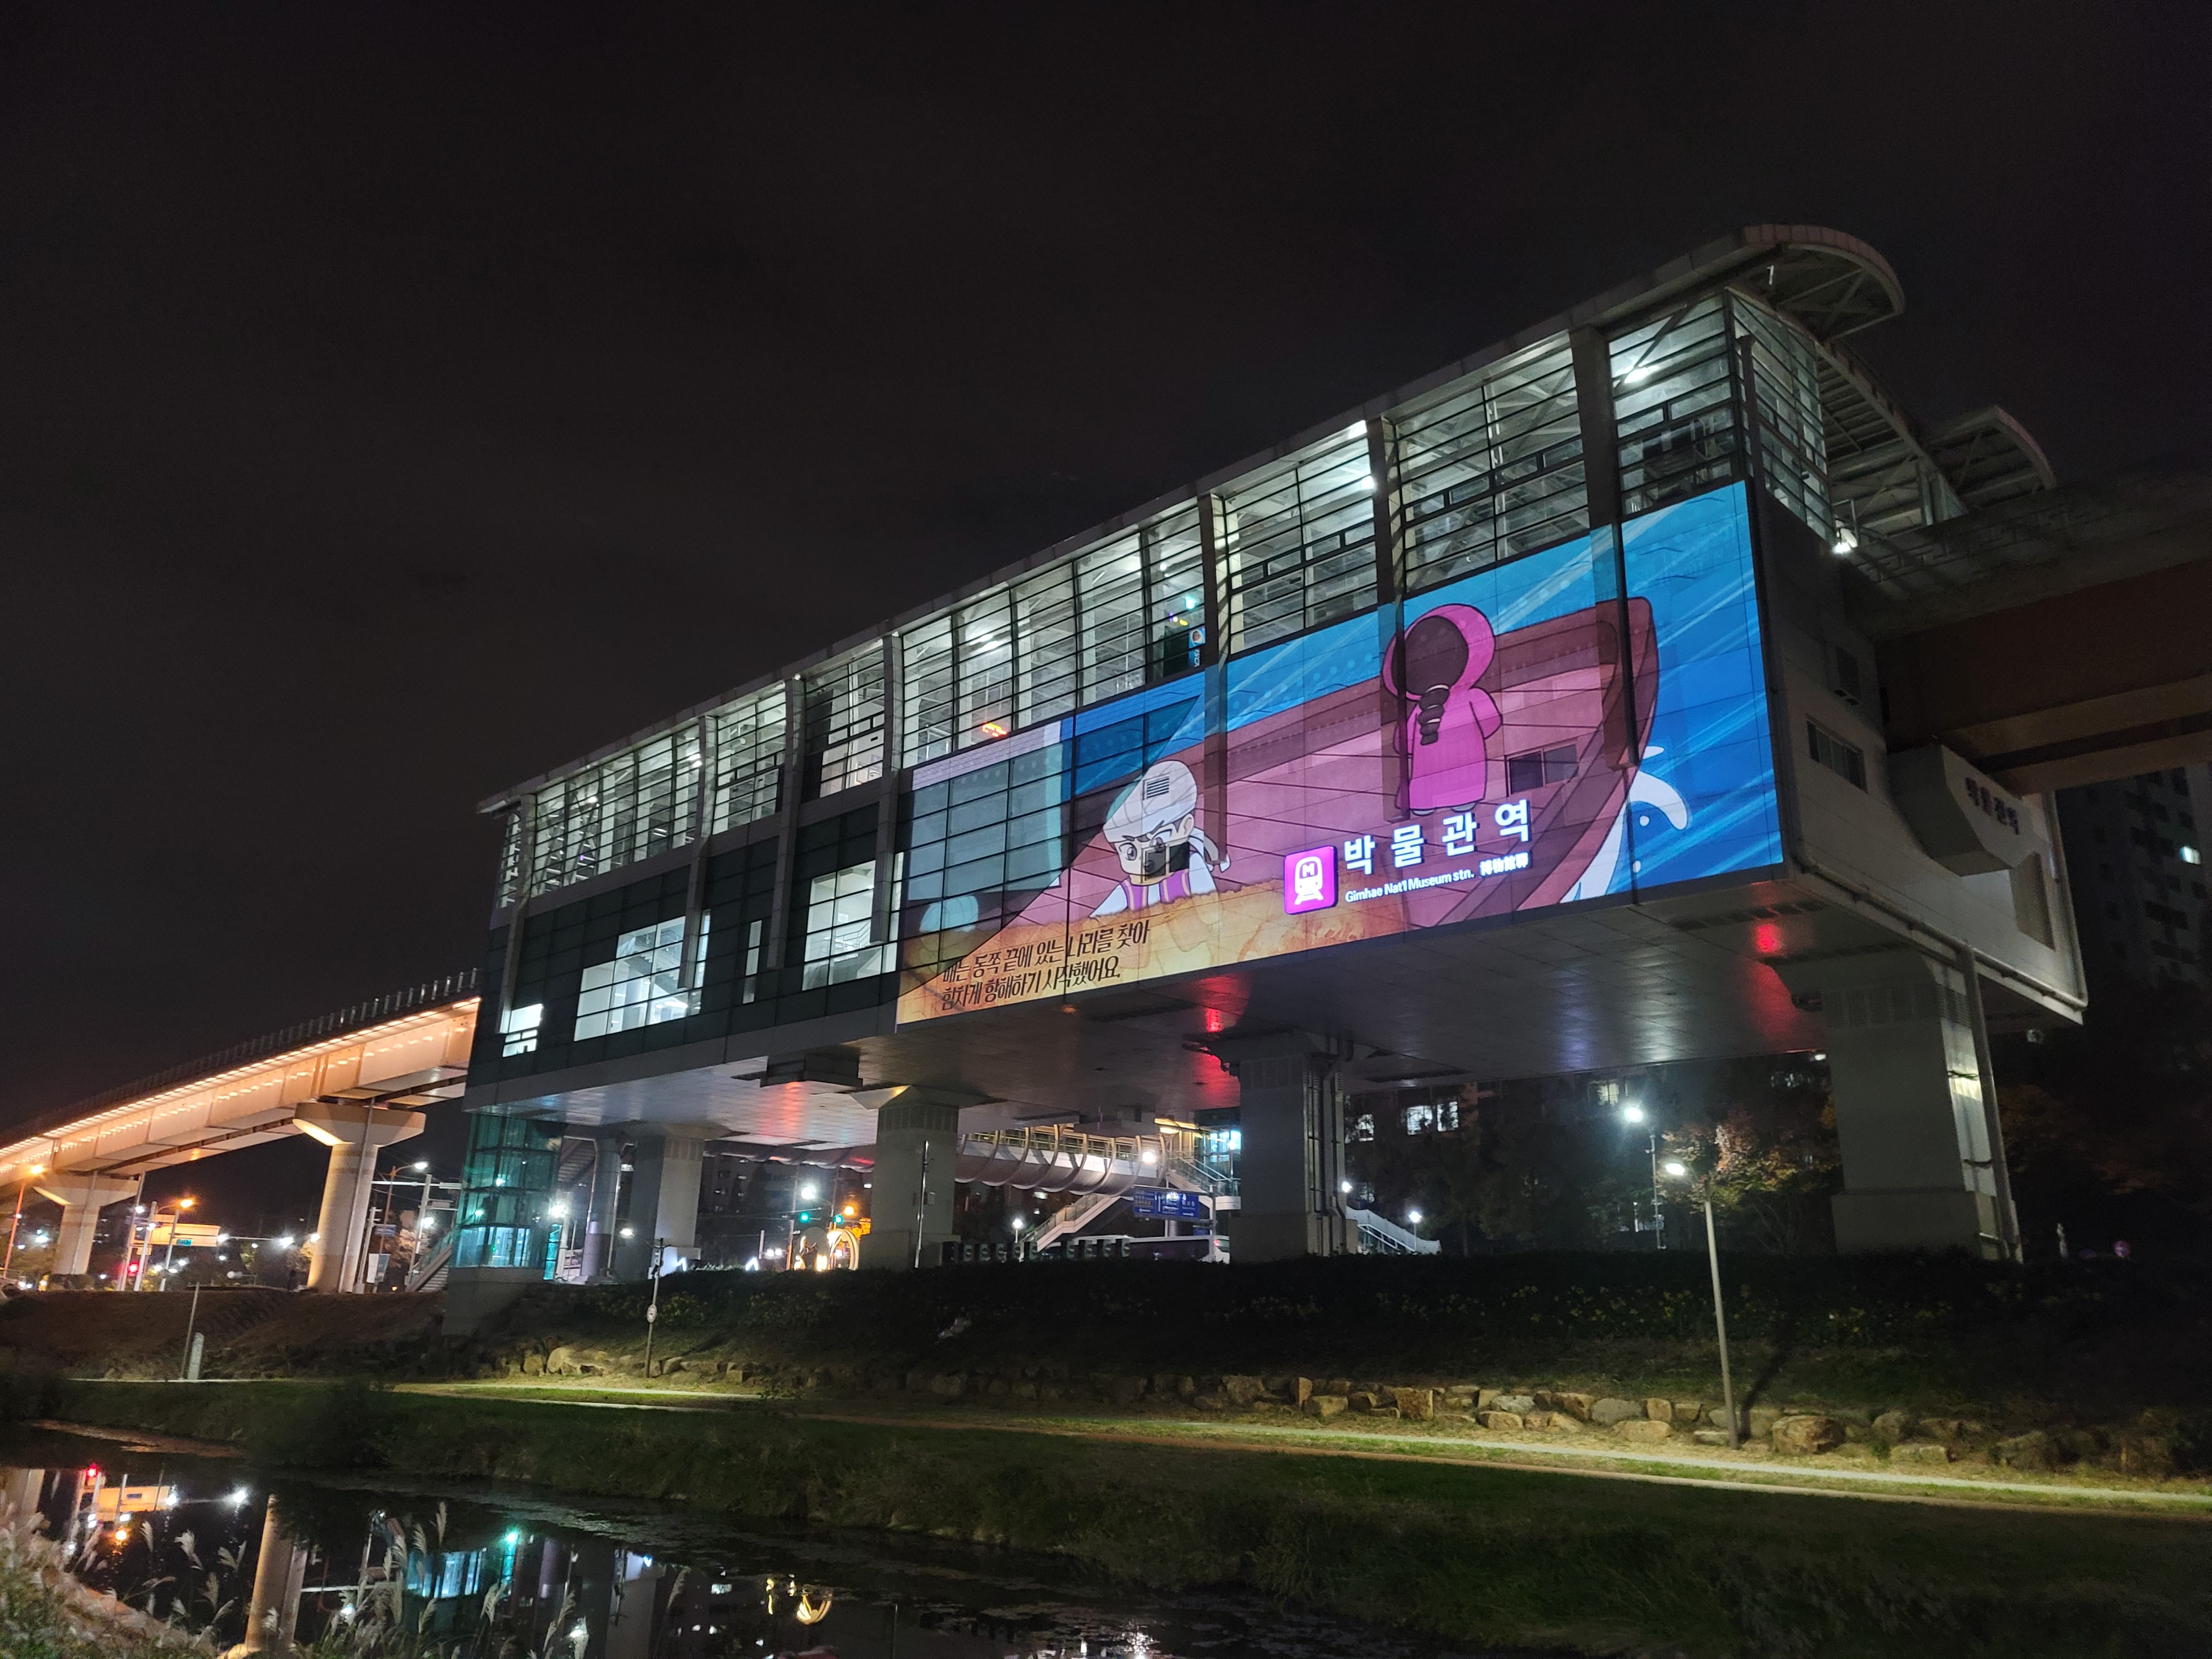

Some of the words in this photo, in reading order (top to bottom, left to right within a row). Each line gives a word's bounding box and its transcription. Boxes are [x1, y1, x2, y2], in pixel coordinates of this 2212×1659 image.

[1345, 886, 1383, 903] Gimhae
[1384, 881, 1408, 895] Nat'l
[1408, 872, 1452, 890] Museum
[1453, 869, 1475, 881] stn.
[973, 951, 1002, 978] 동쪽
[1003, 944, 1034, 972] 끝에
[1034, 940, 1065, 966] 있는
[1066, 927, 1114, 957] 나라를
[1116, 920, 1151, 950] 찾아
[941, 982, 983, 1011] 힘차게
[984, 970, 1042, 1003] 항해하기
[1042, 956, 1120, 990] 시작했어요.
